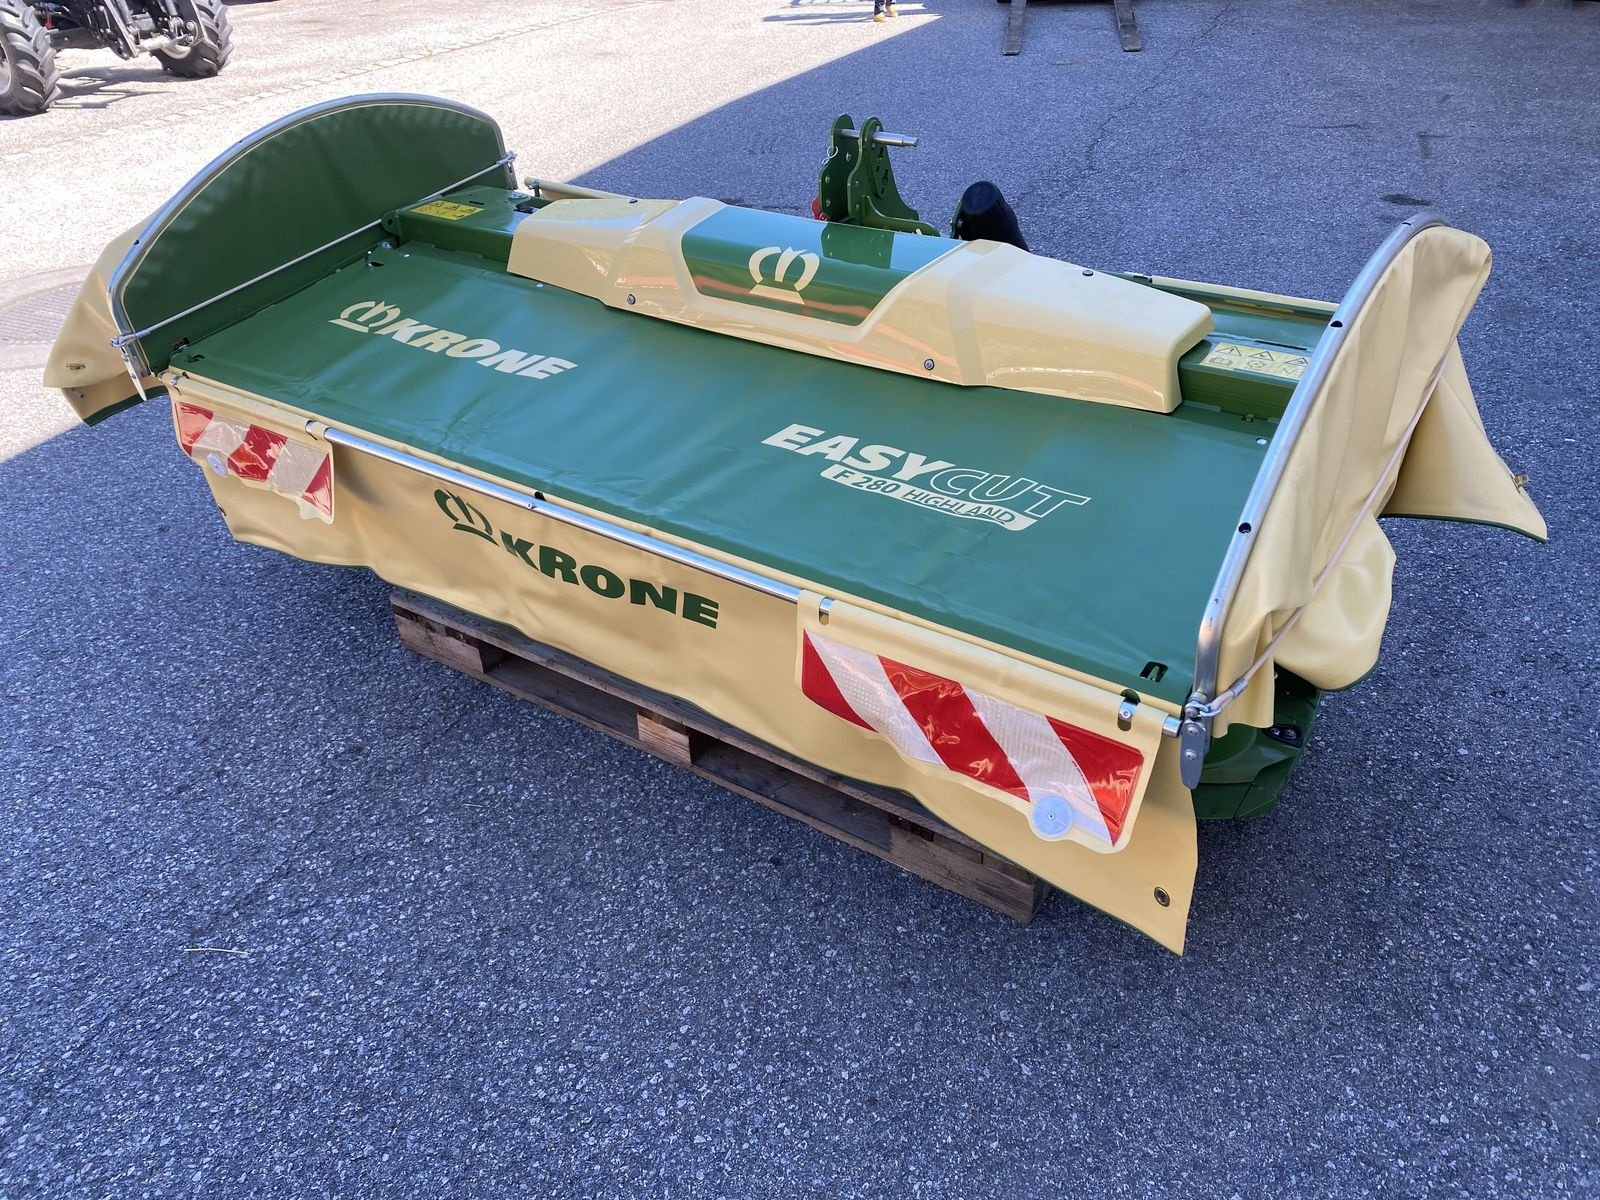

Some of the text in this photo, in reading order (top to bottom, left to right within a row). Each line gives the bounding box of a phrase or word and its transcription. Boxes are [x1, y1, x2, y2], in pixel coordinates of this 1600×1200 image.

[373, 318, 578, 379] KRONE
[760, 423, 1092, 518] EASYCUT
[833, 470, 1016, 525] F 280 HIGHLAND
[499, 528, 720, 630] KRONE
